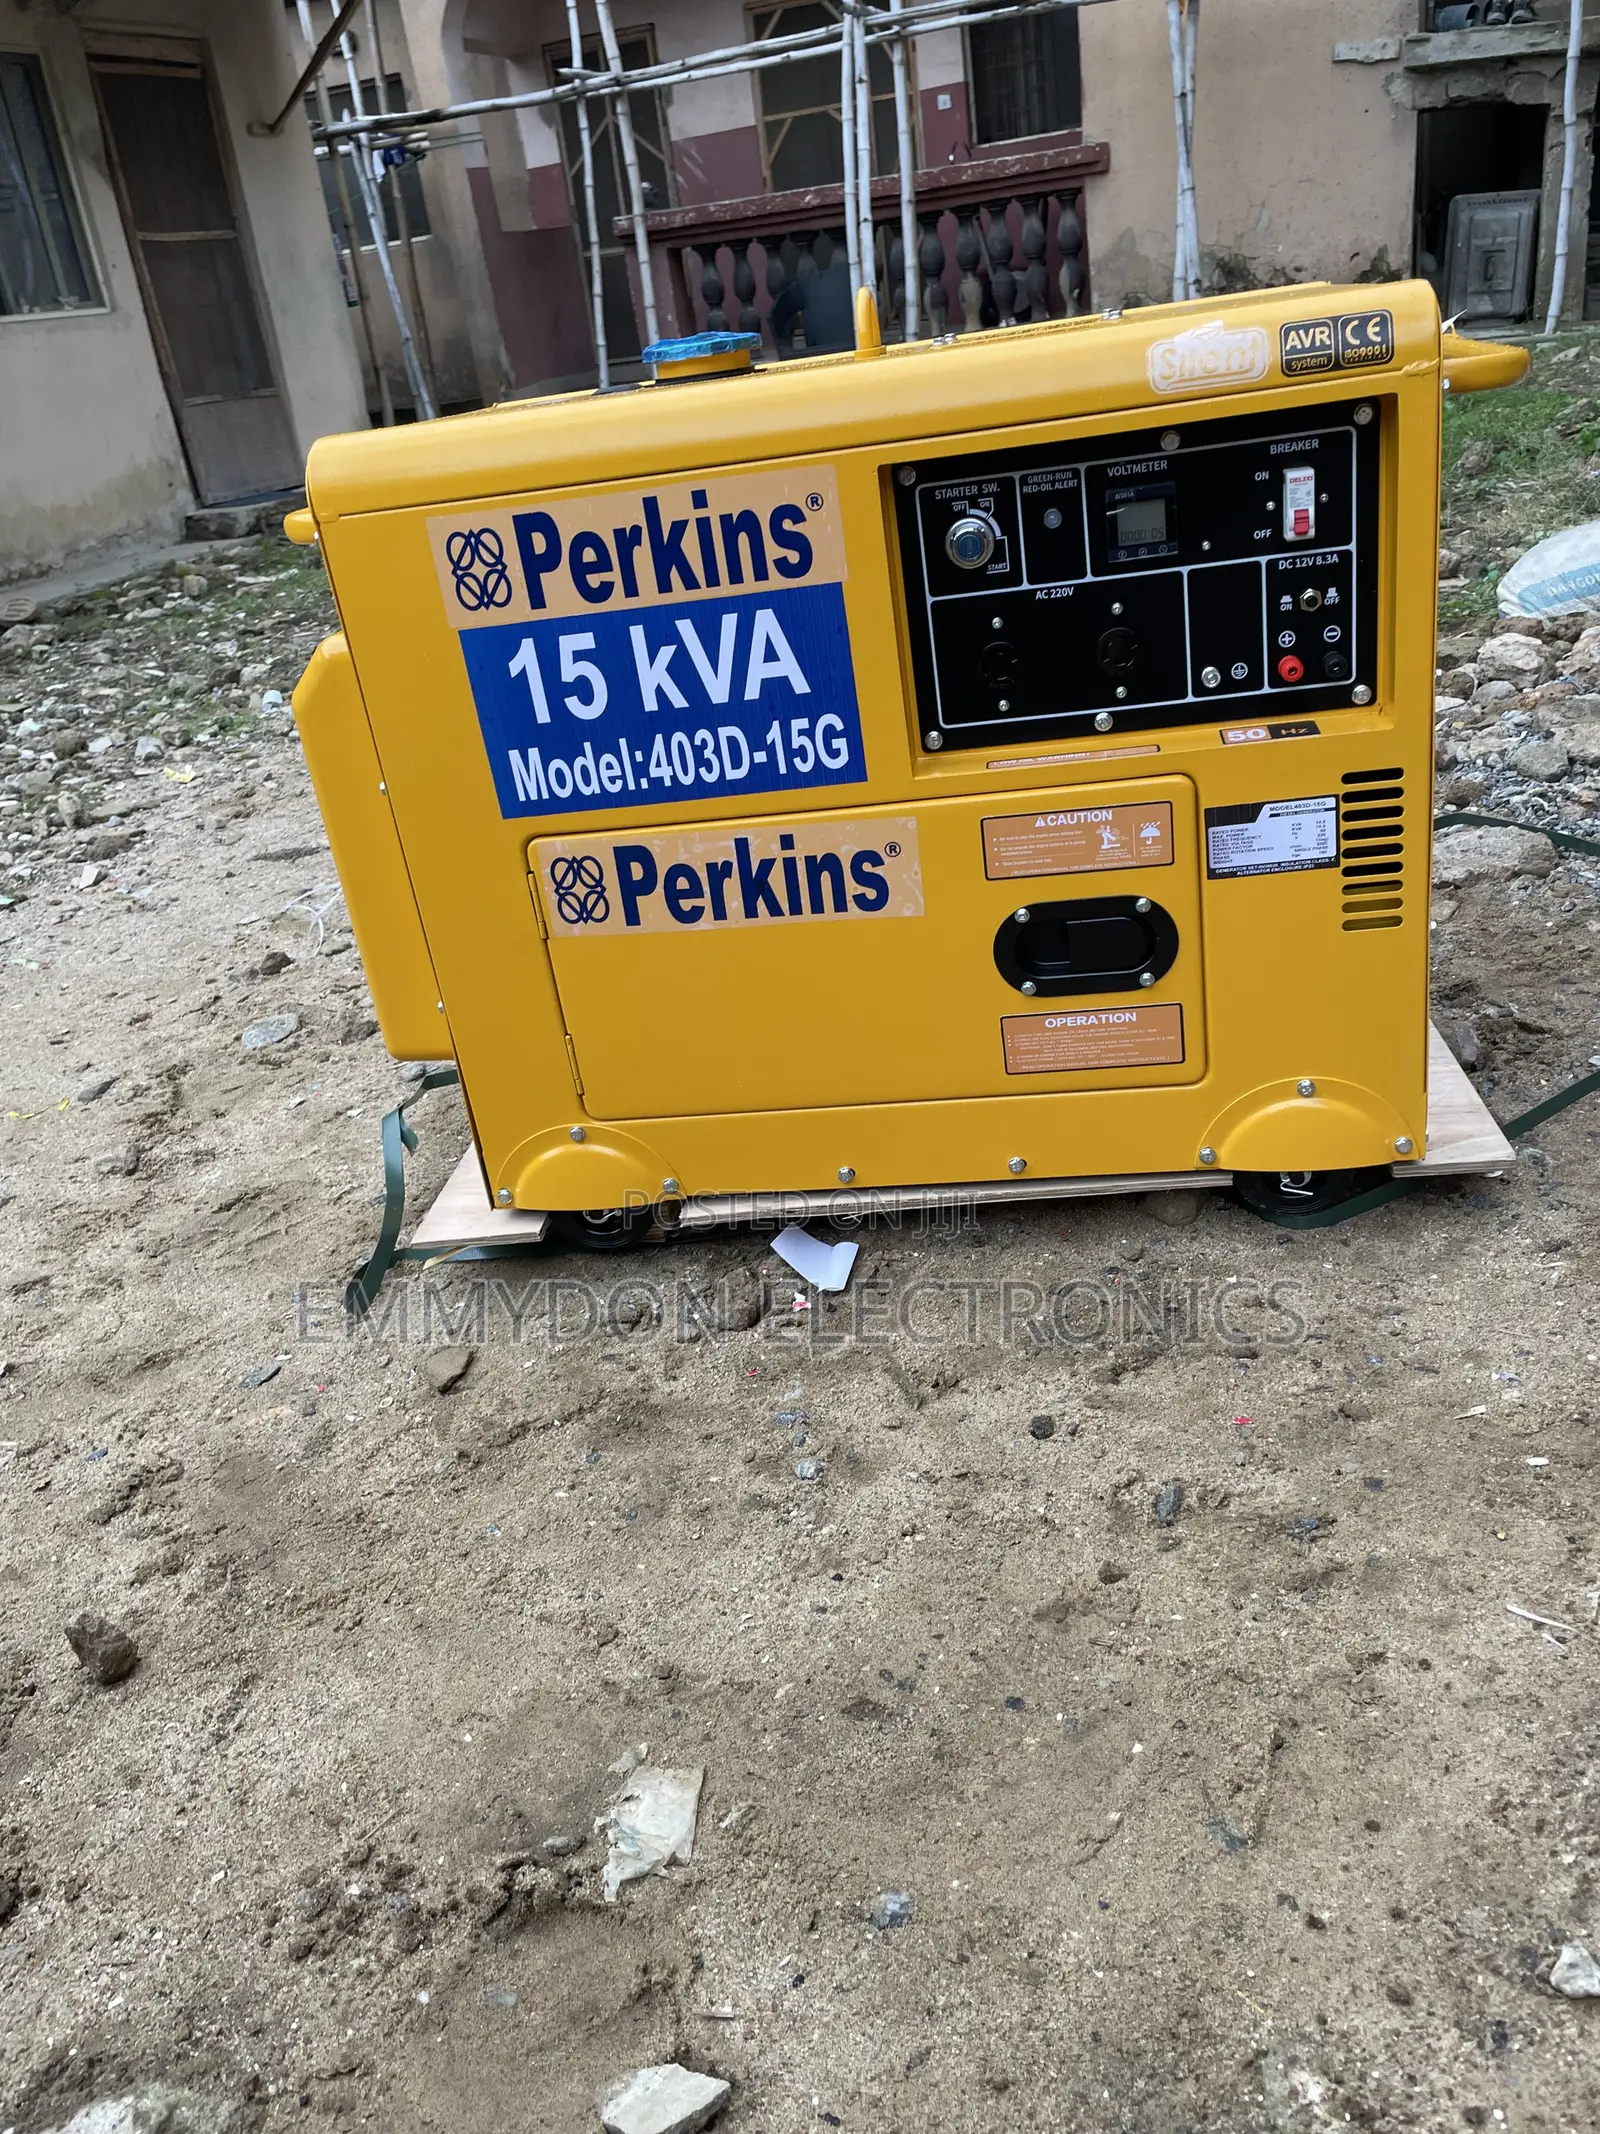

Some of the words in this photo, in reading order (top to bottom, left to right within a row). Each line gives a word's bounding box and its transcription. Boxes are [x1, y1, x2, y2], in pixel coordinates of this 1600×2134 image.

[1286, 326, 1332, 352] AVR
[1291, 356, 1329, 372] system
[1270, 438, 1319, 455] BREAKER
[1107, 460, 1168, 477] VOLTMETER
[1255, 471, 1269, 481] ON
[1027, 470, 1073, 484] GREEN-RUN
[934, 485, 979, 500] STARTER
[981, 482, 1001, 494] SW.
[1022, 481, 1053, 494] RED-OIL
[1054, 479, 1078, 490] ALERT
[953, 504, 966, 512] OFF
[1253, 529, 1272, 540] OFF
[987, 563, 1007, 571] START
[1278, 559, 1293, 571] DC
[1296, 556, 1315, 569] 12V
[1316, 554, 1339, 567] 8.3A
[1036, 588, 1049, 601] AC
[1050, 585, 1075, 600] 220V
[1324, 596, 1340, 605] OFF
[1280, 603, 1293, 611] ON
[507, 630, 608, 722] 15
[628, 608, 812, 713] kVA
[1227, 728, 1267, 743] 50
[1281, 727, 1309, 737] Hz
[507, 713, 850, 803] Model:403D-15G
[1046, 809, 1113, 827] CAUTION
[1044, 1012, 1137, 1028] OPERATION
